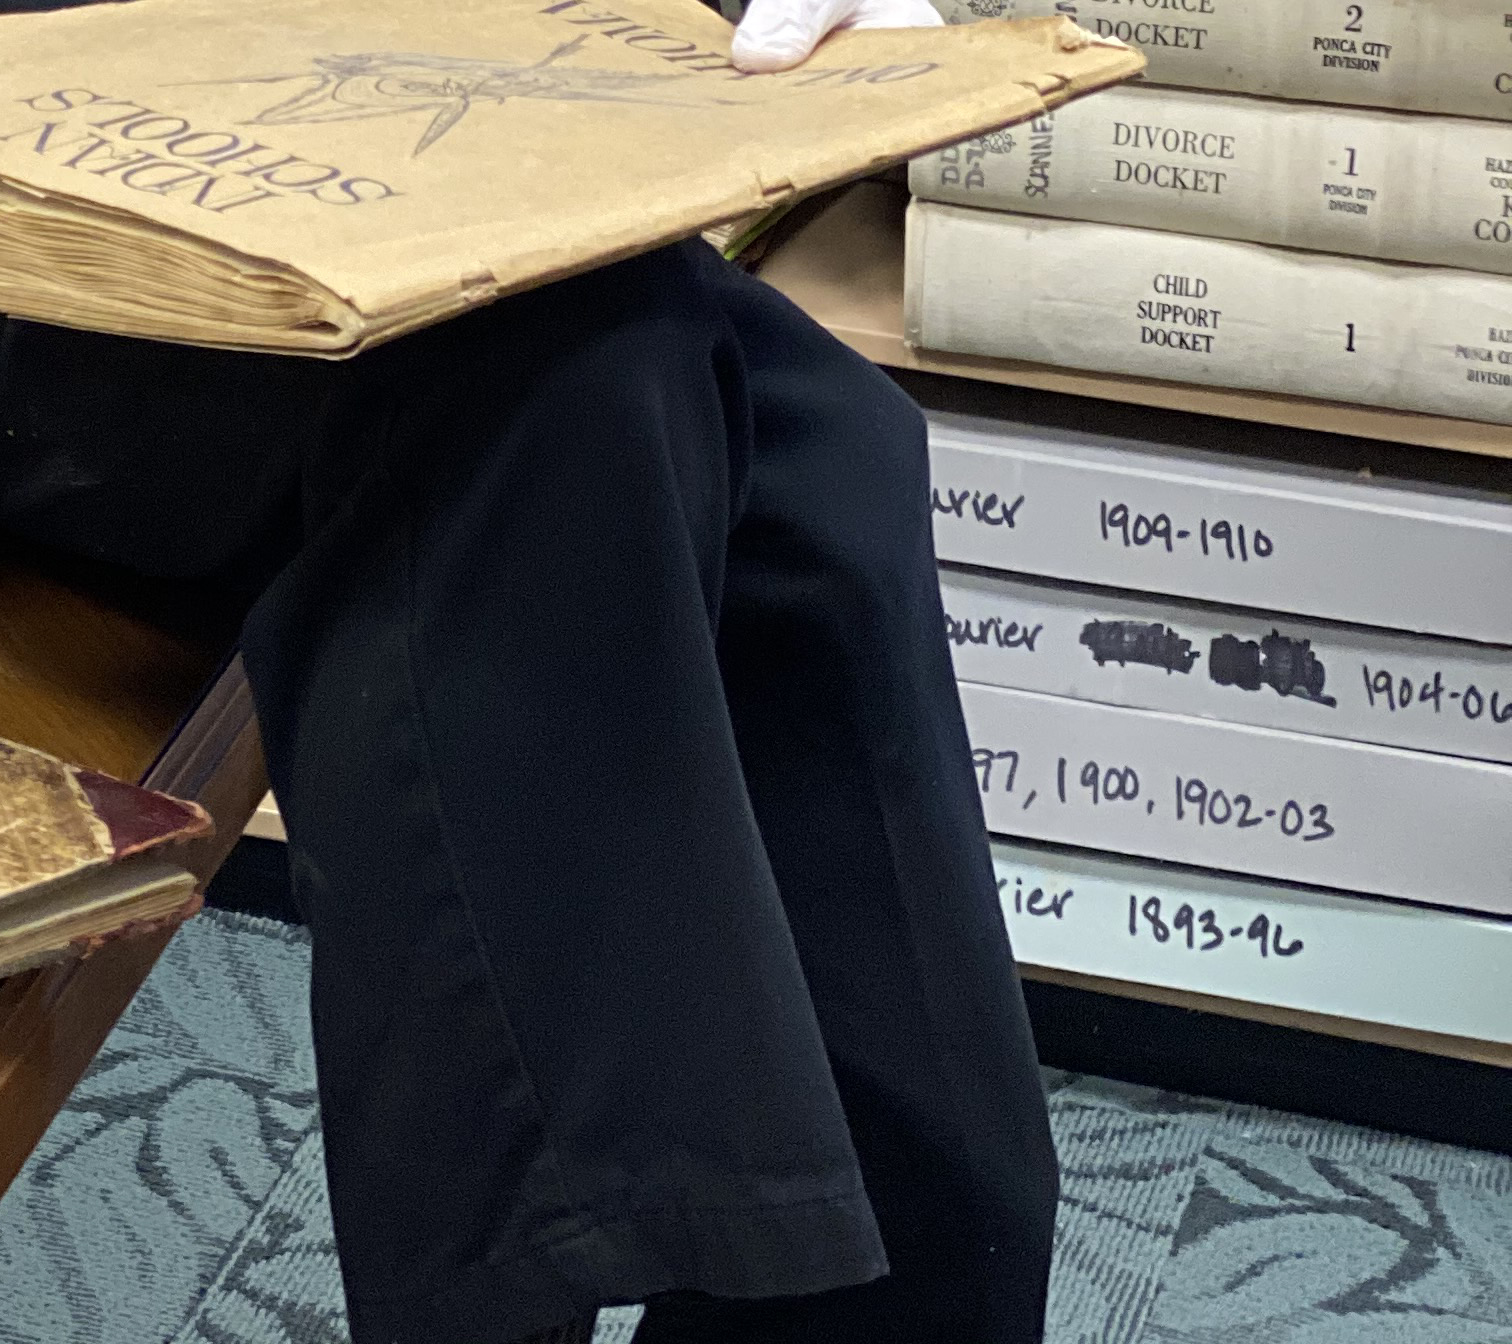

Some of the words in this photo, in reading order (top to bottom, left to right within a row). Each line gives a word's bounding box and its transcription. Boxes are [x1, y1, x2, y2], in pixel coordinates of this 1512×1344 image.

[1096, 19, 1209, 49] DOCKET
[1344, 5, 1363, 32] 2
[1314, 38, 1358, 55] PONCA
[1362, 41, 1392, 59] CITY
[1323, 55, 1380, 72] DIVISION
[13, 87, 406, 206] SCHOOLS
[1112, 122, 1235, 161] DIVORCE
[1114, 160, 1227, 195] DOCKET
[1152, 274, 1209, 299] CHILD
[1136, 300, 1222, 332] SUPPORT
[1140, 326, 1214, 354] DOCKET
[1345, 323, 1357, 353] 1
[1100, 501, 1274, 562] 1909-1910
[1363, 664, 1512, 724] 1904-06
[1058, 758, 1156, 815] 1900,
[1175, 778, 1335, 842] 1902-03
[1128, 894, 1305, 957] 1893-96
